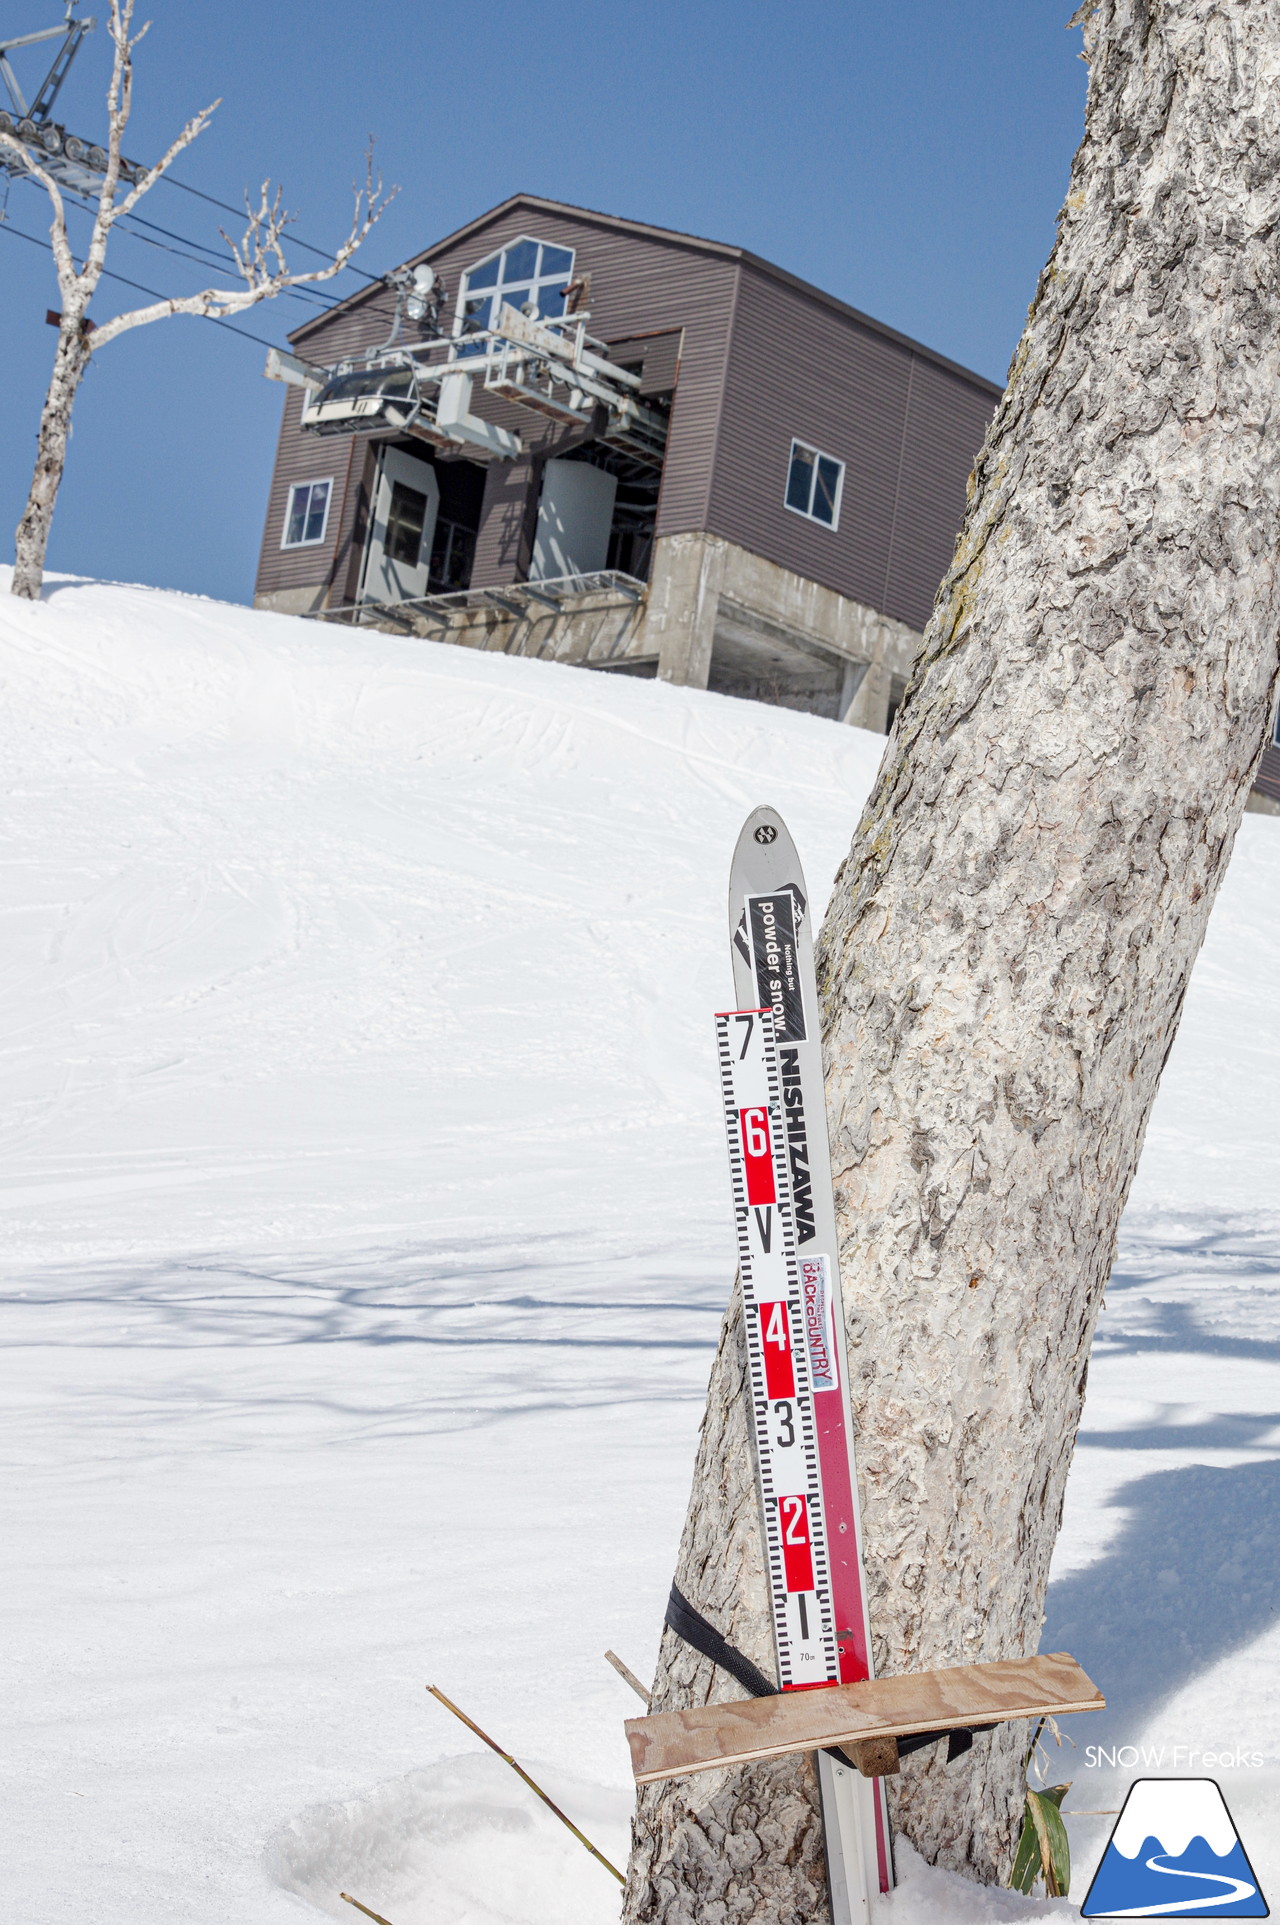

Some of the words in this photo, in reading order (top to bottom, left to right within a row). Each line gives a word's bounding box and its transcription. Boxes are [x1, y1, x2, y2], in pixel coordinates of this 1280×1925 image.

[758, 902, 782, 972] powder
[770, 979, 786, 1037] snow.
[784, 944, 794, 976] Nothing
[787, 977, 795, 991] but
[735, 1015, 754, 1060] 7
[745, 1108, 767, 1158] 6
[779, 1048, 816, 1245] NISHIZAWA
[765, 1302, 786, 1351] 4
[774, 1401, 795, 1448] 3
[783, 1496, 806, 1546] 2
